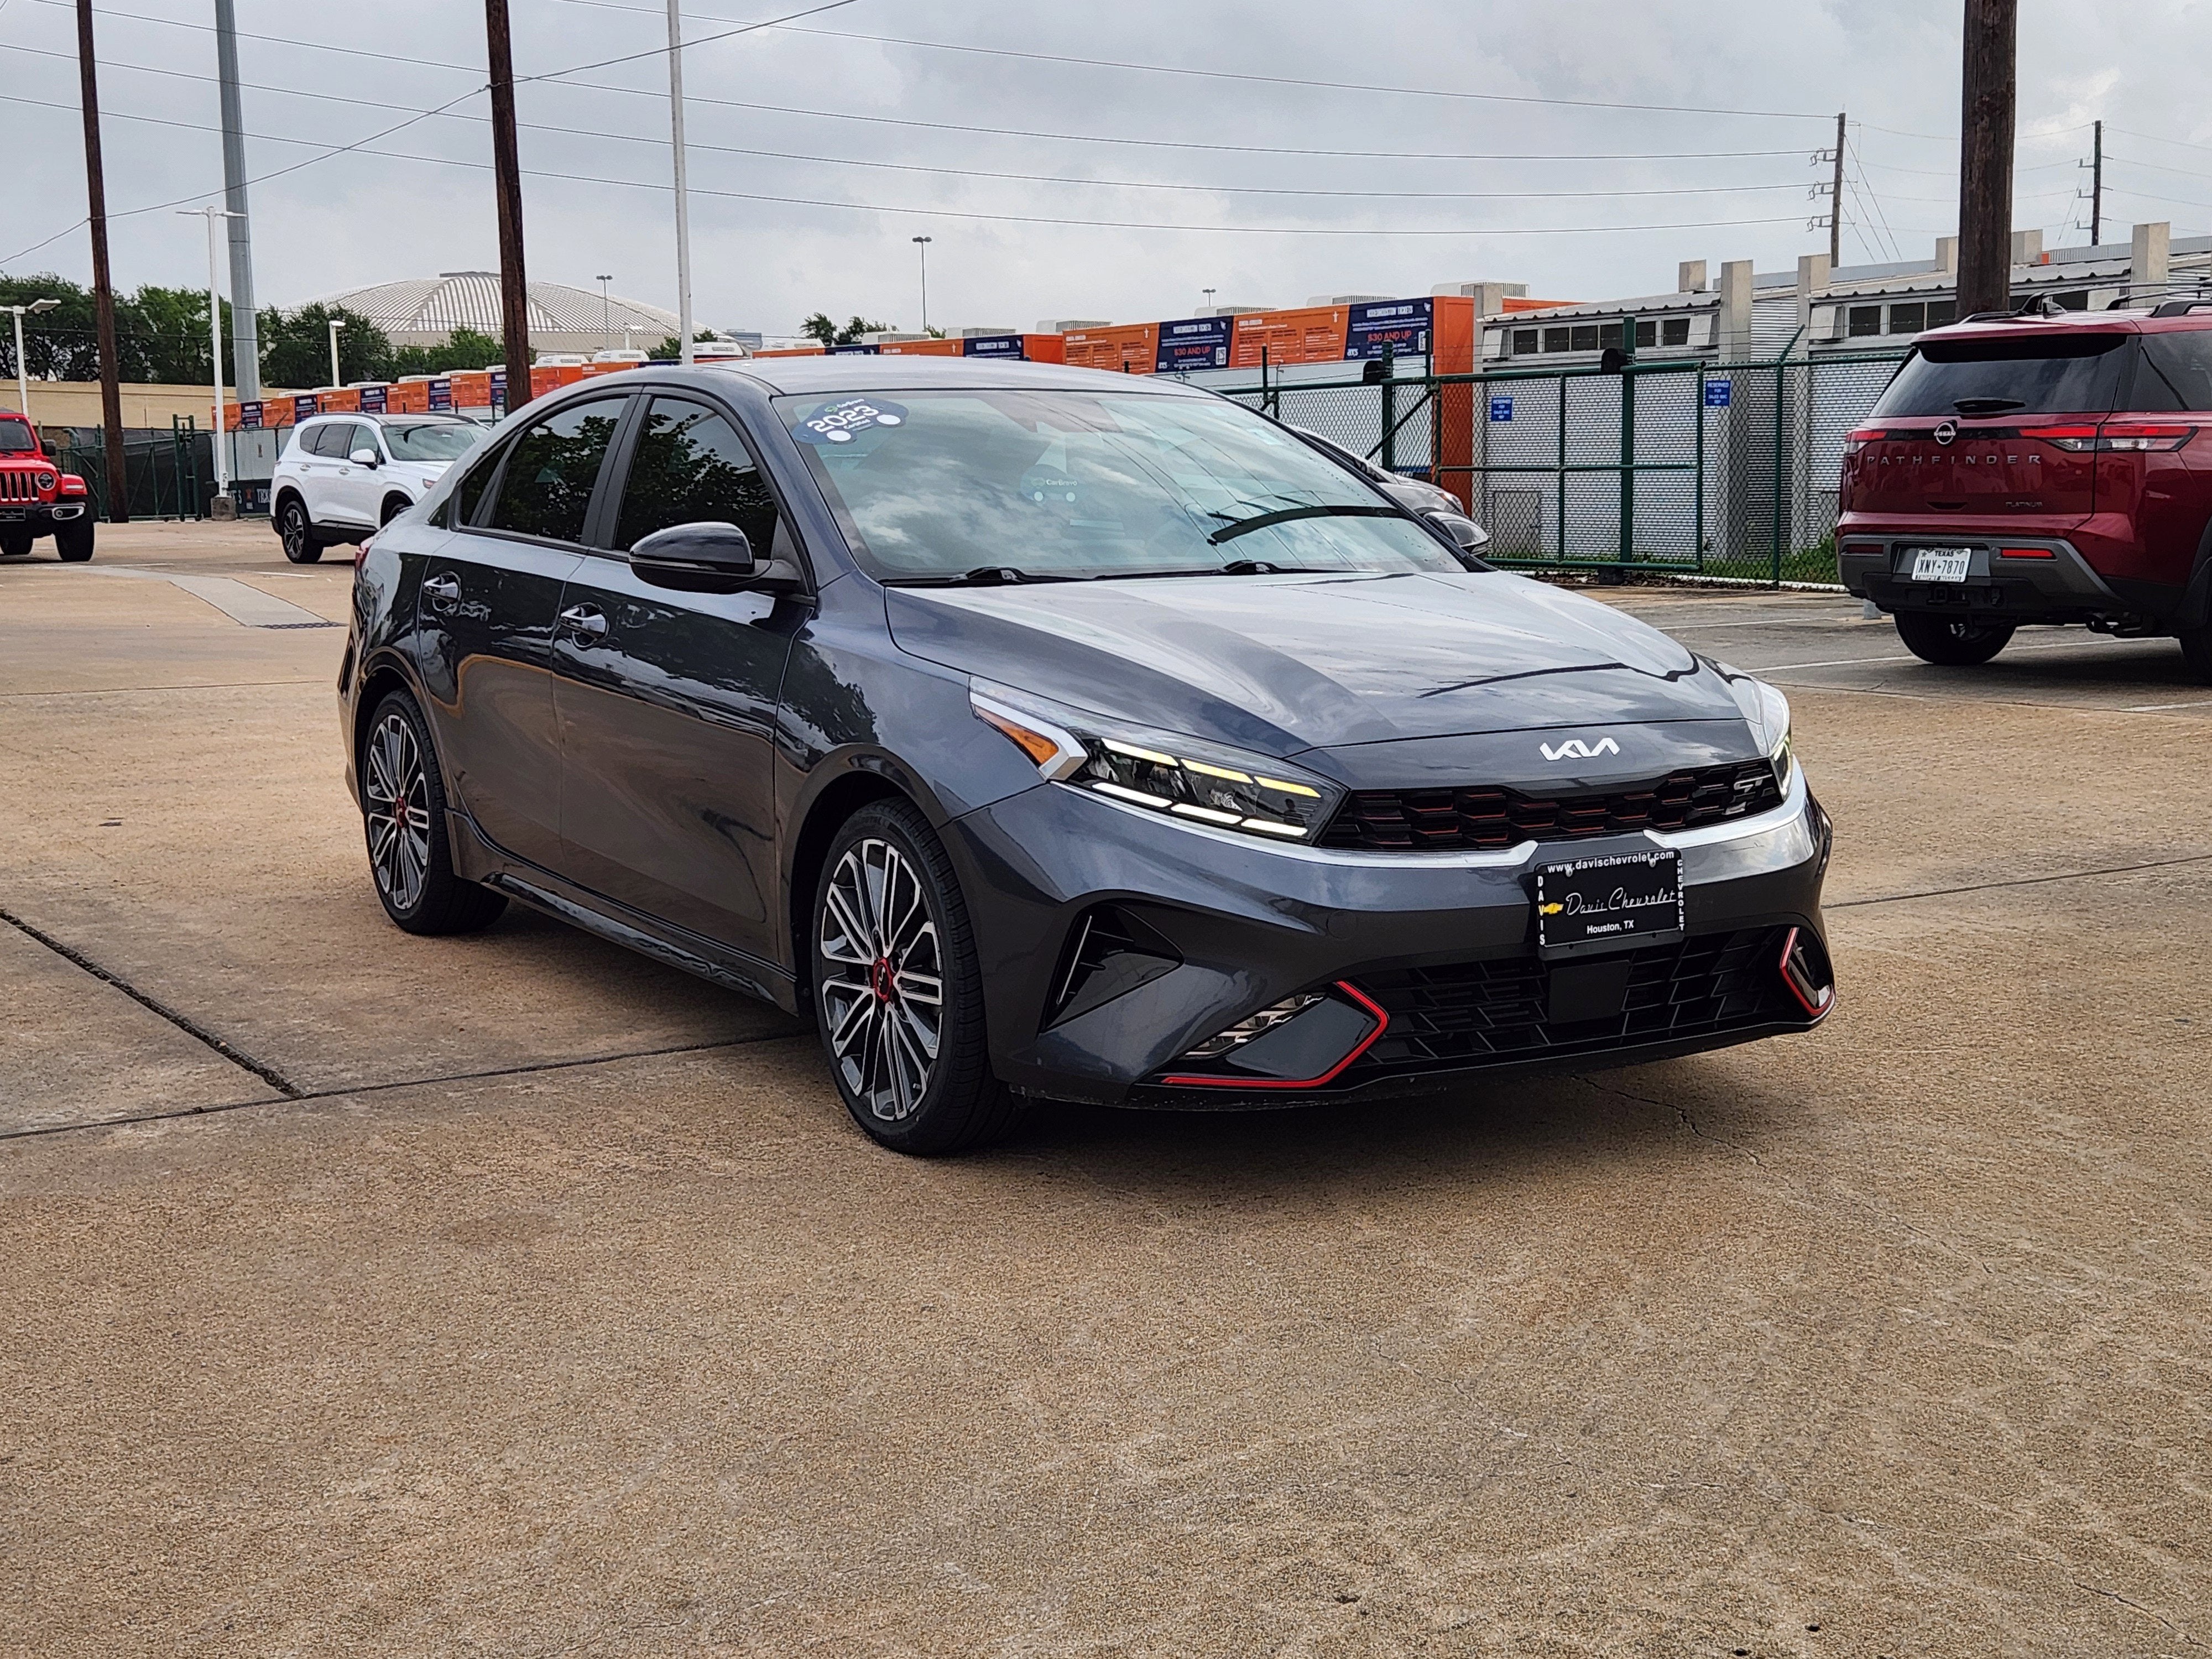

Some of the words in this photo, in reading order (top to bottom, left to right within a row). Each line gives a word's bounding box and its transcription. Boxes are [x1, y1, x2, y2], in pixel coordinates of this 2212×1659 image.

[1368, 333, 1383, 342] $30
[1384, 331, 1400, 341] AND
[1401, 330, 1412, 340] UP
[1187, 346, 1201, 356] AND
[1202, 346, 1211, 354] UP
[807, 405, 879, 432] 2023
[1866, 455, 2041, 466] PATHFINDER
[1547, 851, 1674, 874] www.davischevrolet.com
[1537, 875, 1546, 946] DAVIS
[1565, 892, 1608, 916] Davis
[1608, 886, 1677, 910] Chevrolet
[1587, 924, 1622, 935] Houston,
[1623, 919, 1635, 928] TX
